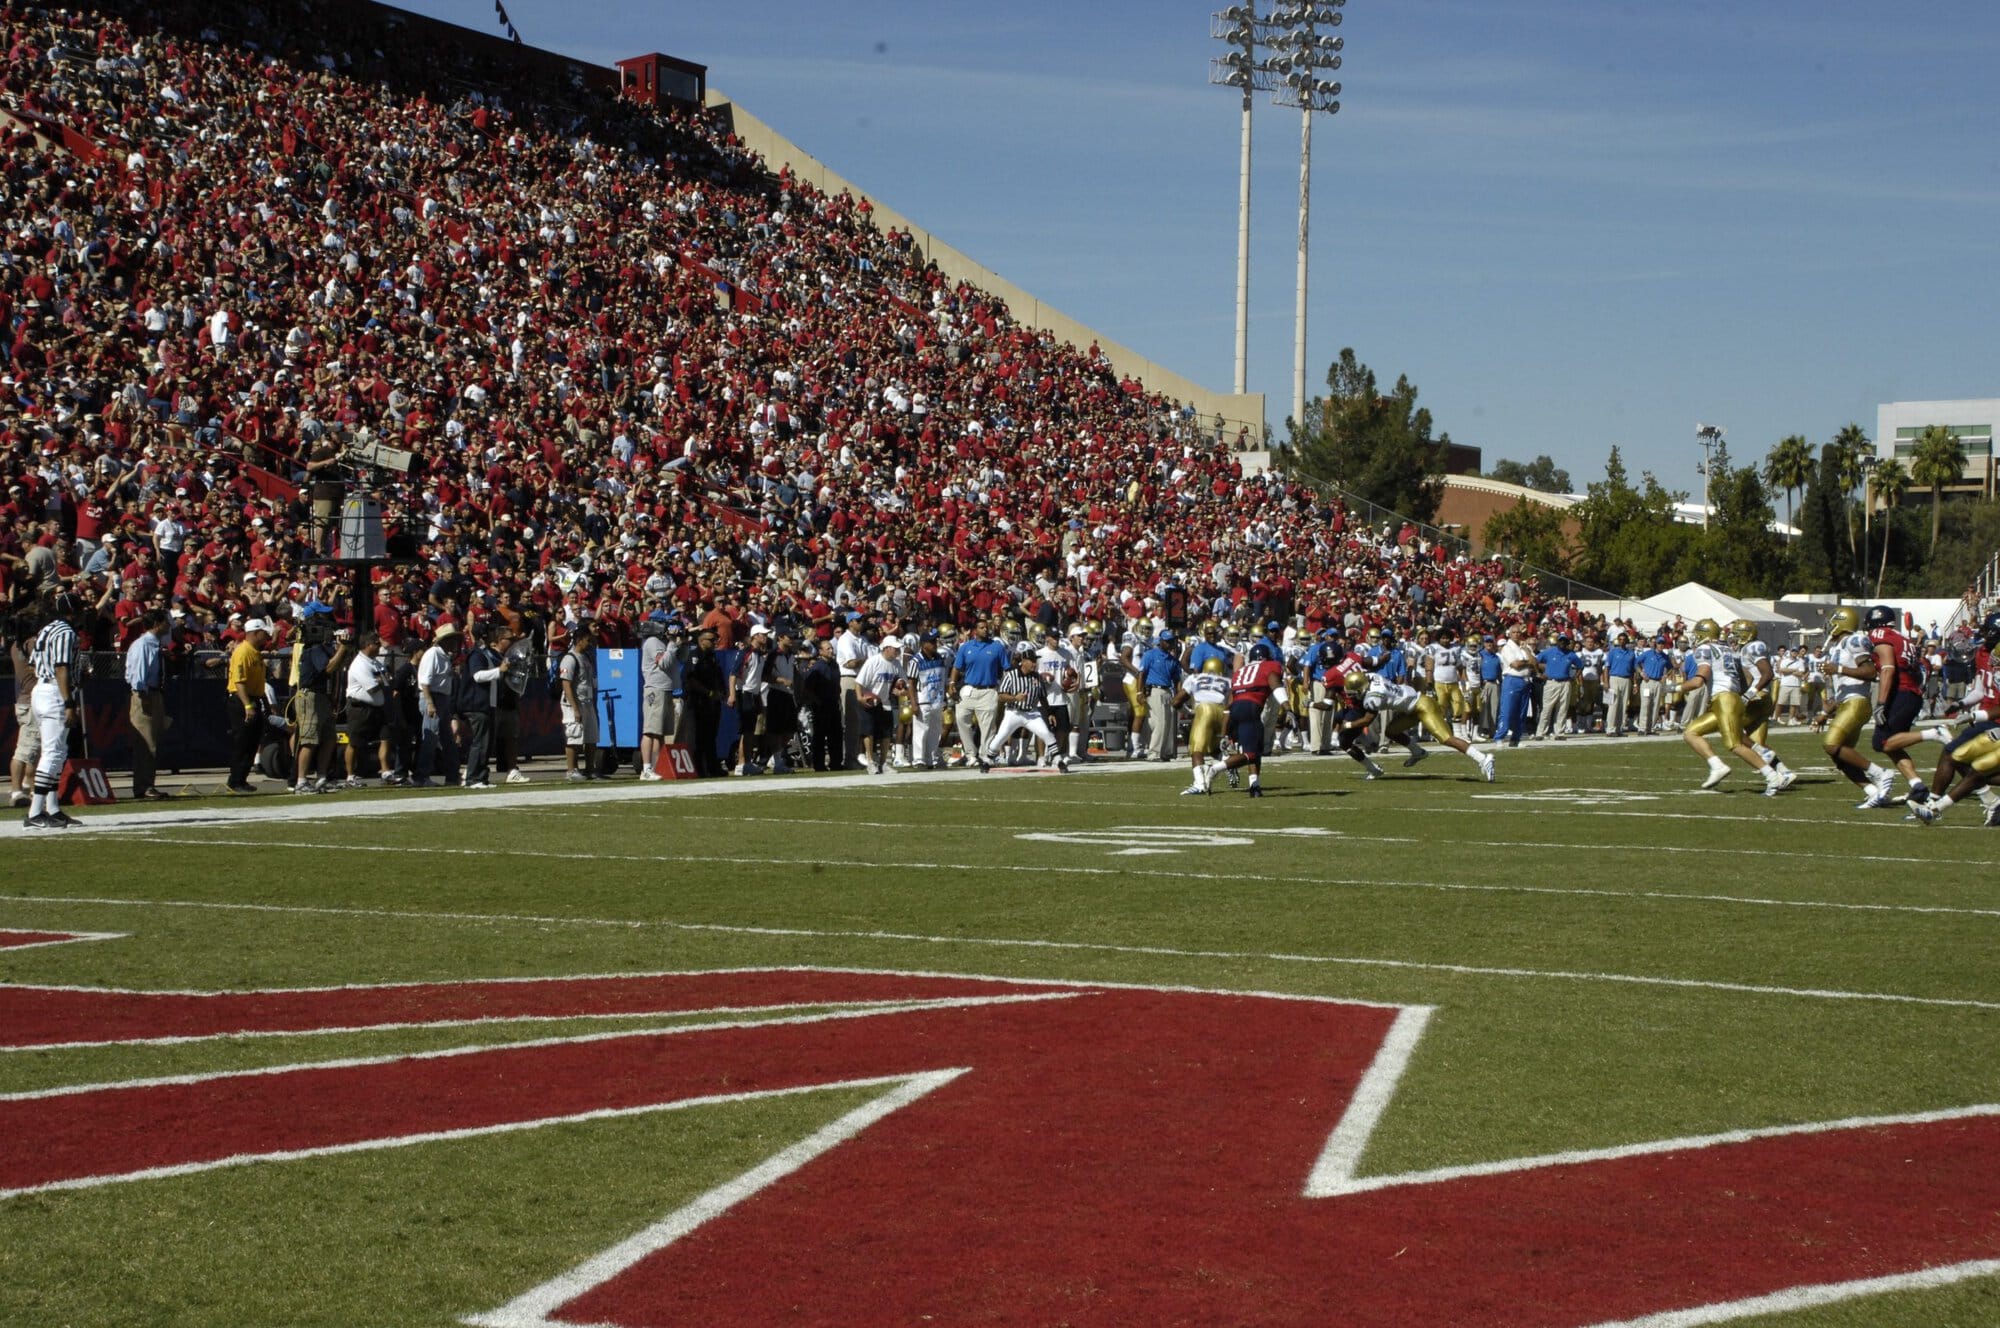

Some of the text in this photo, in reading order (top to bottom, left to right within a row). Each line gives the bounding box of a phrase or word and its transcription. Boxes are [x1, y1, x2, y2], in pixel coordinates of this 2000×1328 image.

[1171, 591, 1184, 618] 2
[1085, 664, 1093, 683] 2
[1233, 663, 1260, 687] 10
[671, 748, 695, 773] 20
[77, 767, 109, 798] 10
